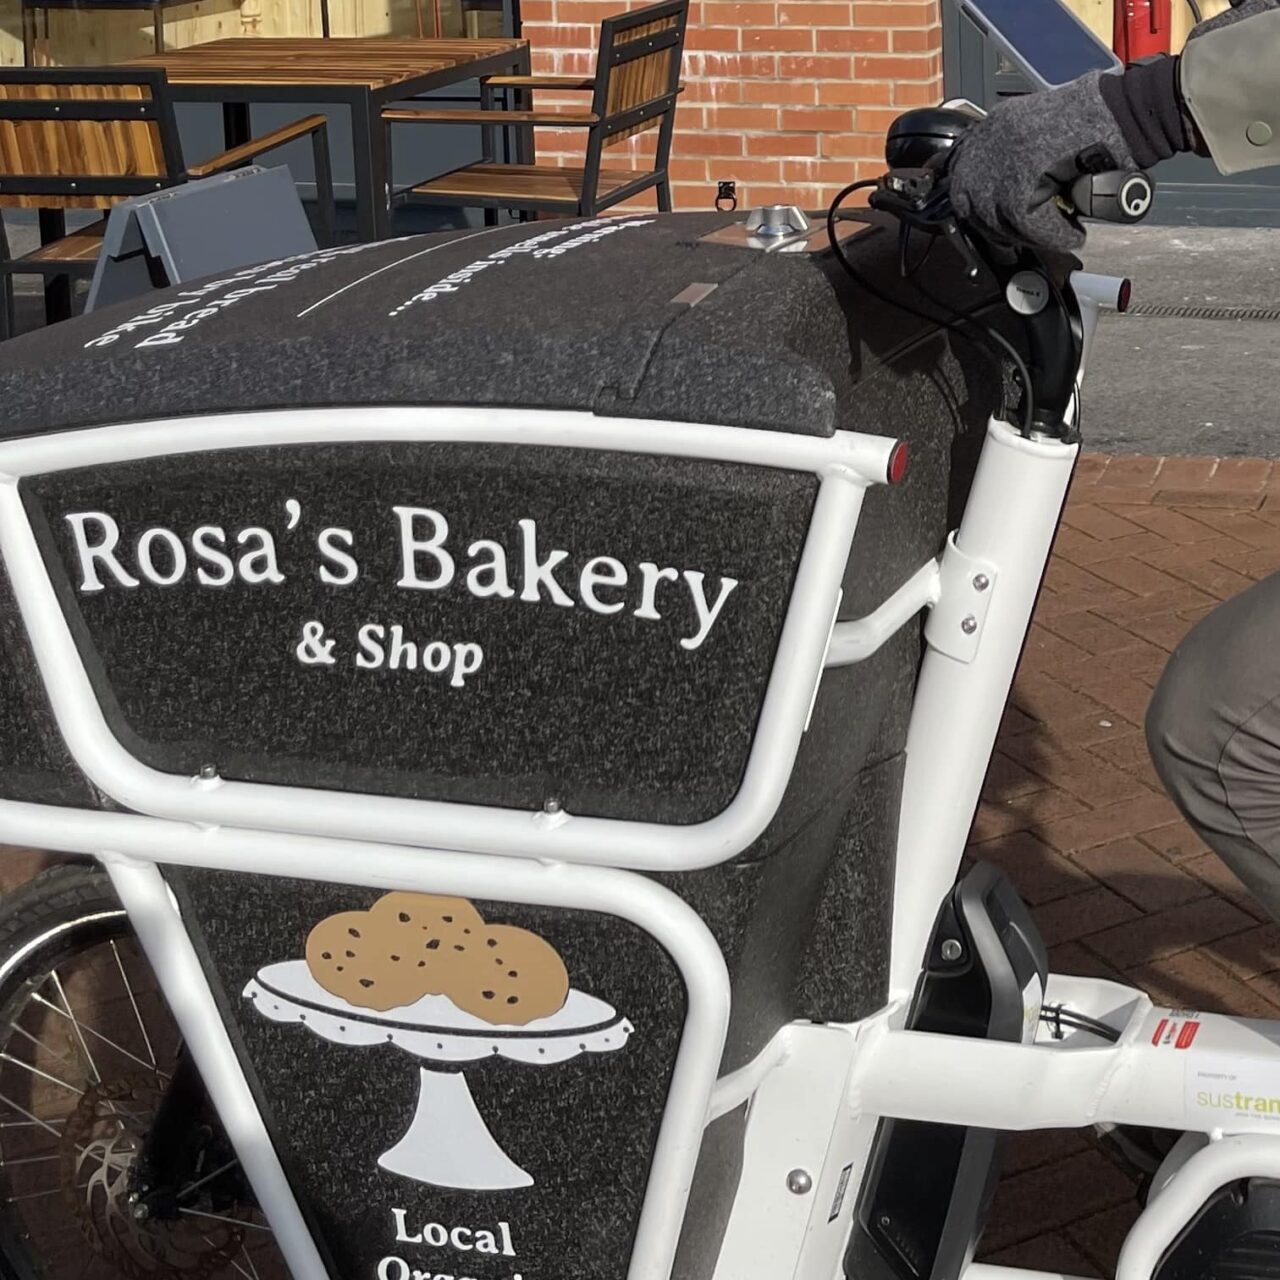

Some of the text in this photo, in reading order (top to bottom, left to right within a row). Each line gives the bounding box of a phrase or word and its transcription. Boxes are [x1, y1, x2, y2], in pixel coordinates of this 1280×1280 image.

[83, 298, 200, 349] bike
[133, 284, 278, 349] bread
[63, 498, 739, 650] Rosa's Bakery
[296, 621, 485, 688] & Shop
[390, 1207, 517, 1256] Local
